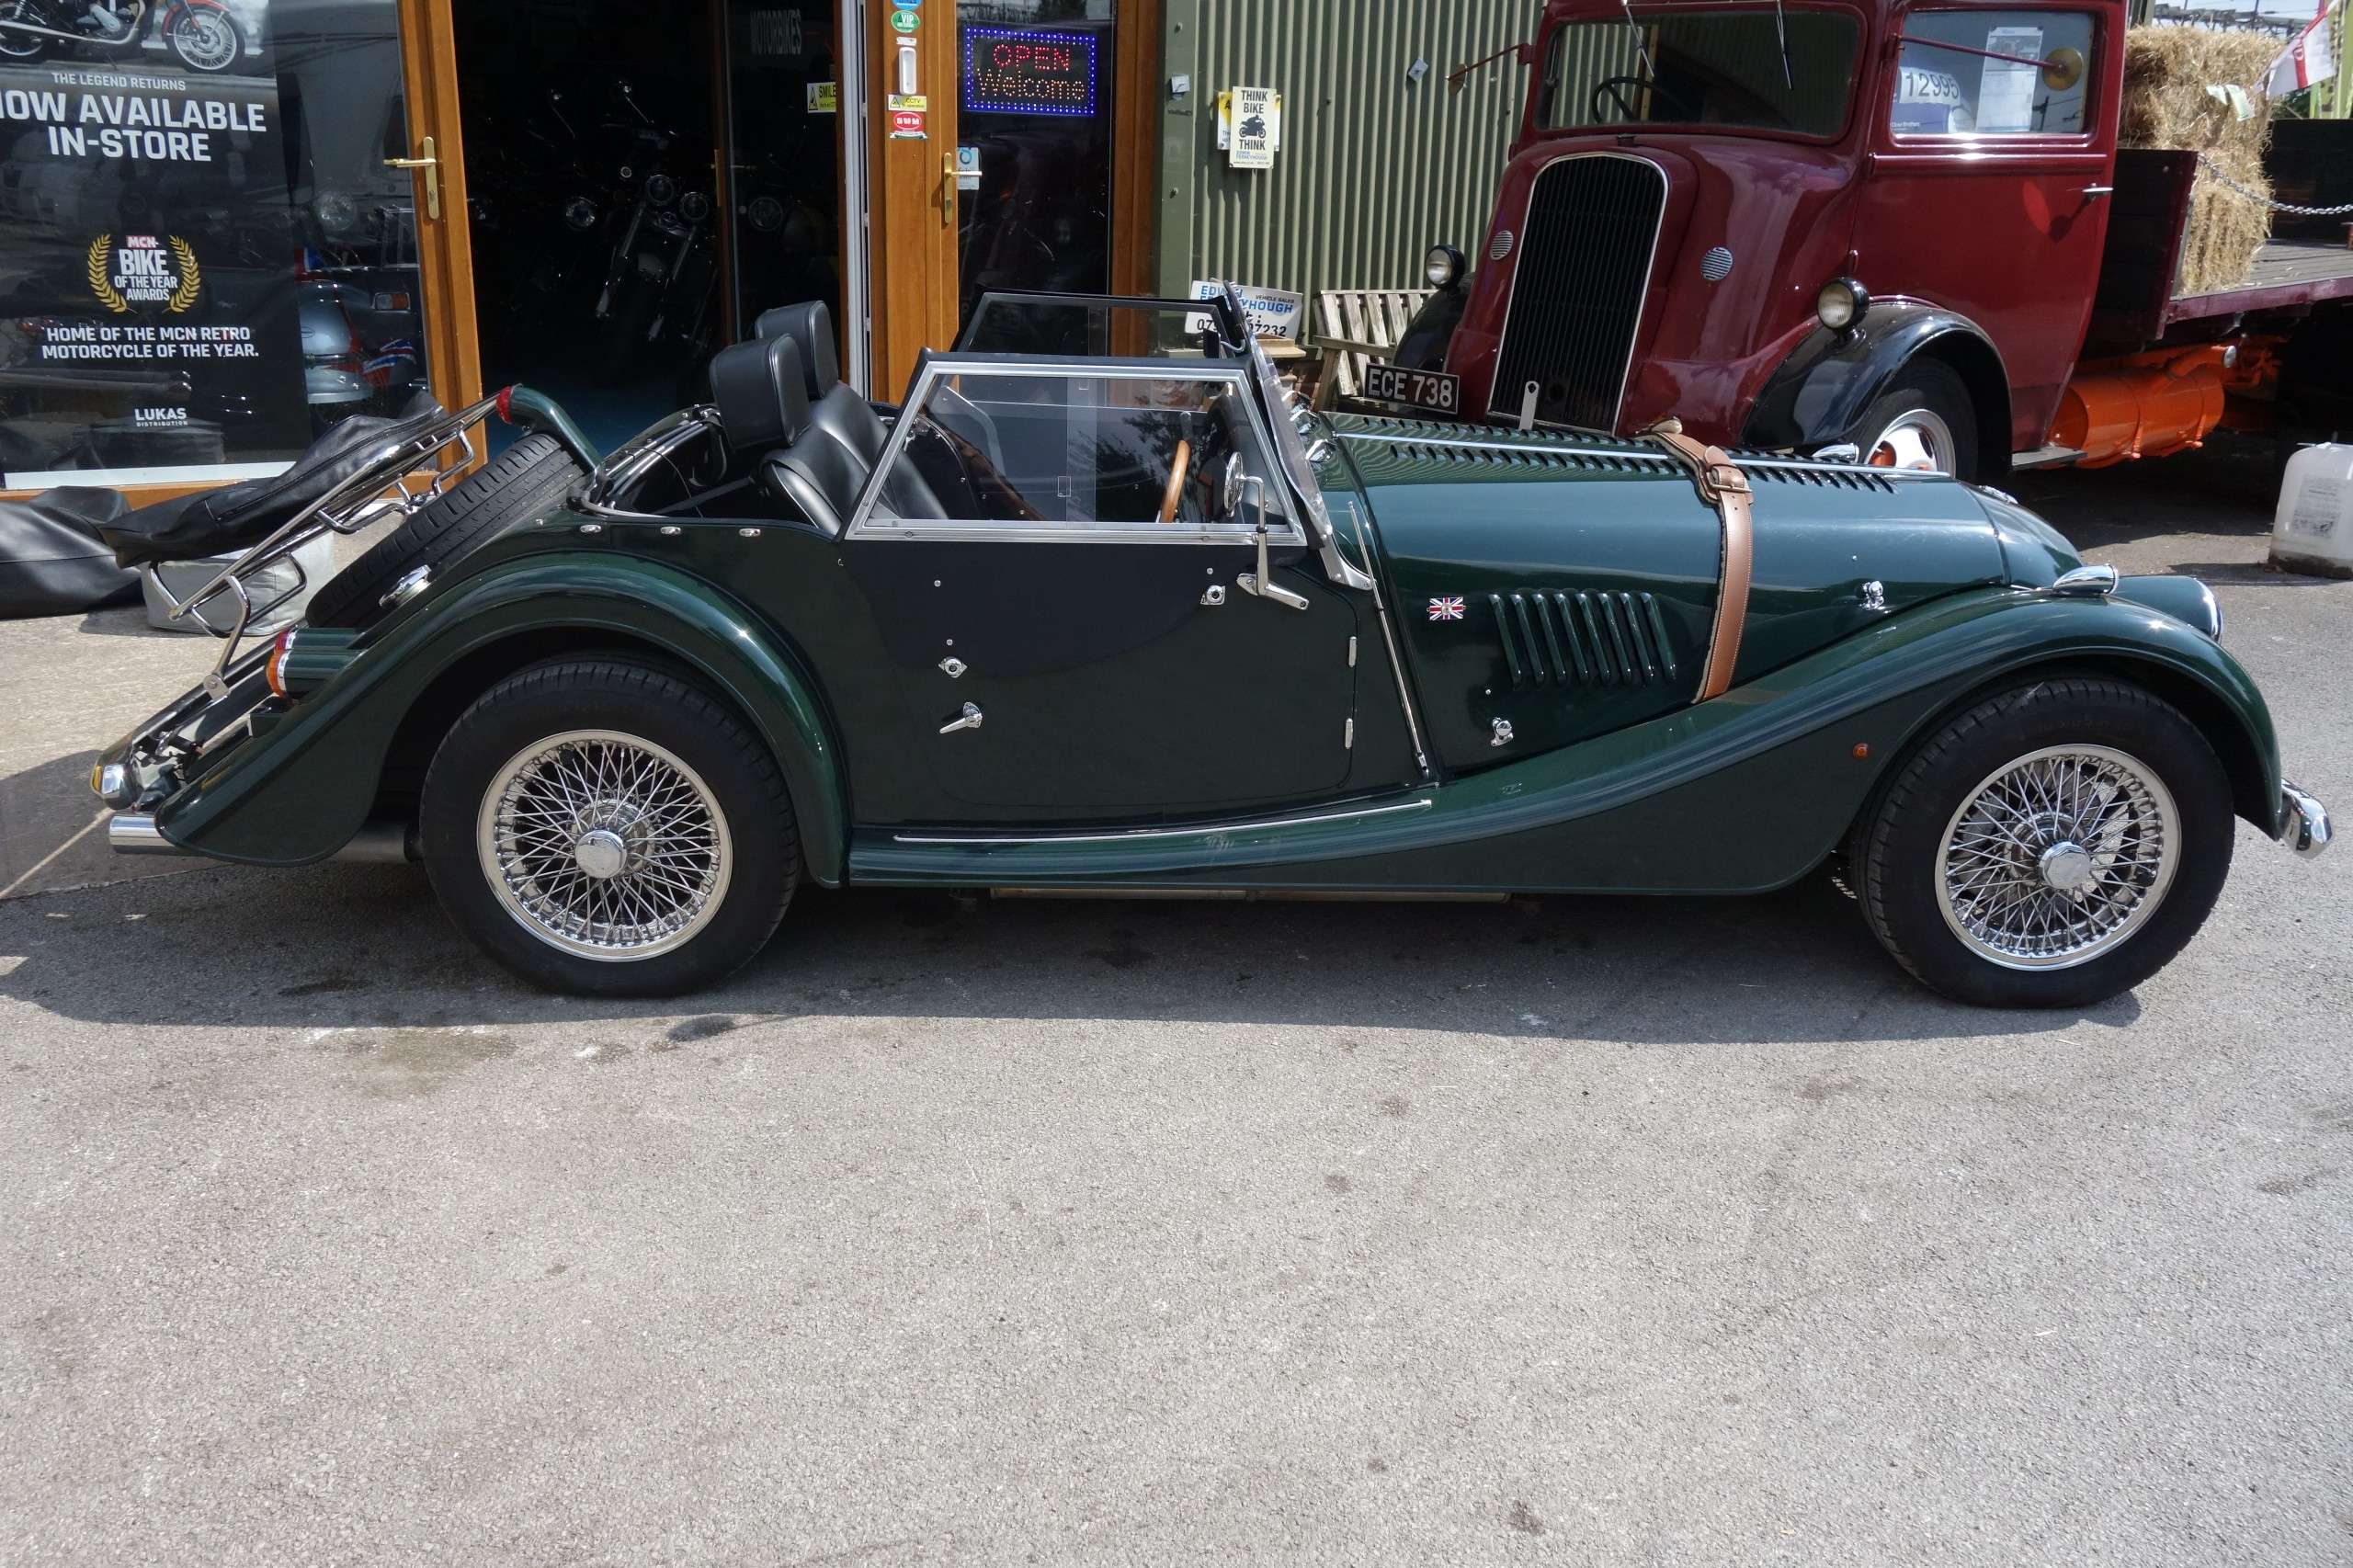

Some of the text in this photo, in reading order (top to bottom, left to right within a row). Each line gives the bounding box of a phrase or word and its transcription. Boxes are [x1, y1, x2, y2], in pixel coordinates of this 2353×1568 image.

[750, 9, 801, 55] MOTORBIKES
[993, 44, 1070, 71] OPEN
[51, 73, 187, 91] THE LEGEND RETURNS
[977, 68, 1086, 100] Welcome
[1905, 73, 1960, 99] 12995
[819, 85, 836, 97] SMILE
[1241, 90, 1267, 102] THINK
[0, 90, 267, 132] OW AVAILABLE
[1244, 102, 1264, 114] BIKE
[49, 126, 212, 162] IN-STORE
[1239, 139, 1266, 151] THINK
[127, 236, 156, 248] MCN
[119, 249, 170, 276] BIKE
[114, 276, 178, 289] OF THE YEAR
[126, 288, 171, 301] AWARDS
[47, 326, 250, 342] HOME OF THE MCN RETRO
[41, 343, 259, 359] MOTORCYCLE OF THE YEAR.
[1368, 368, 1452, 407] ECE 738
[134, 407, 188, 421] LUKAS
